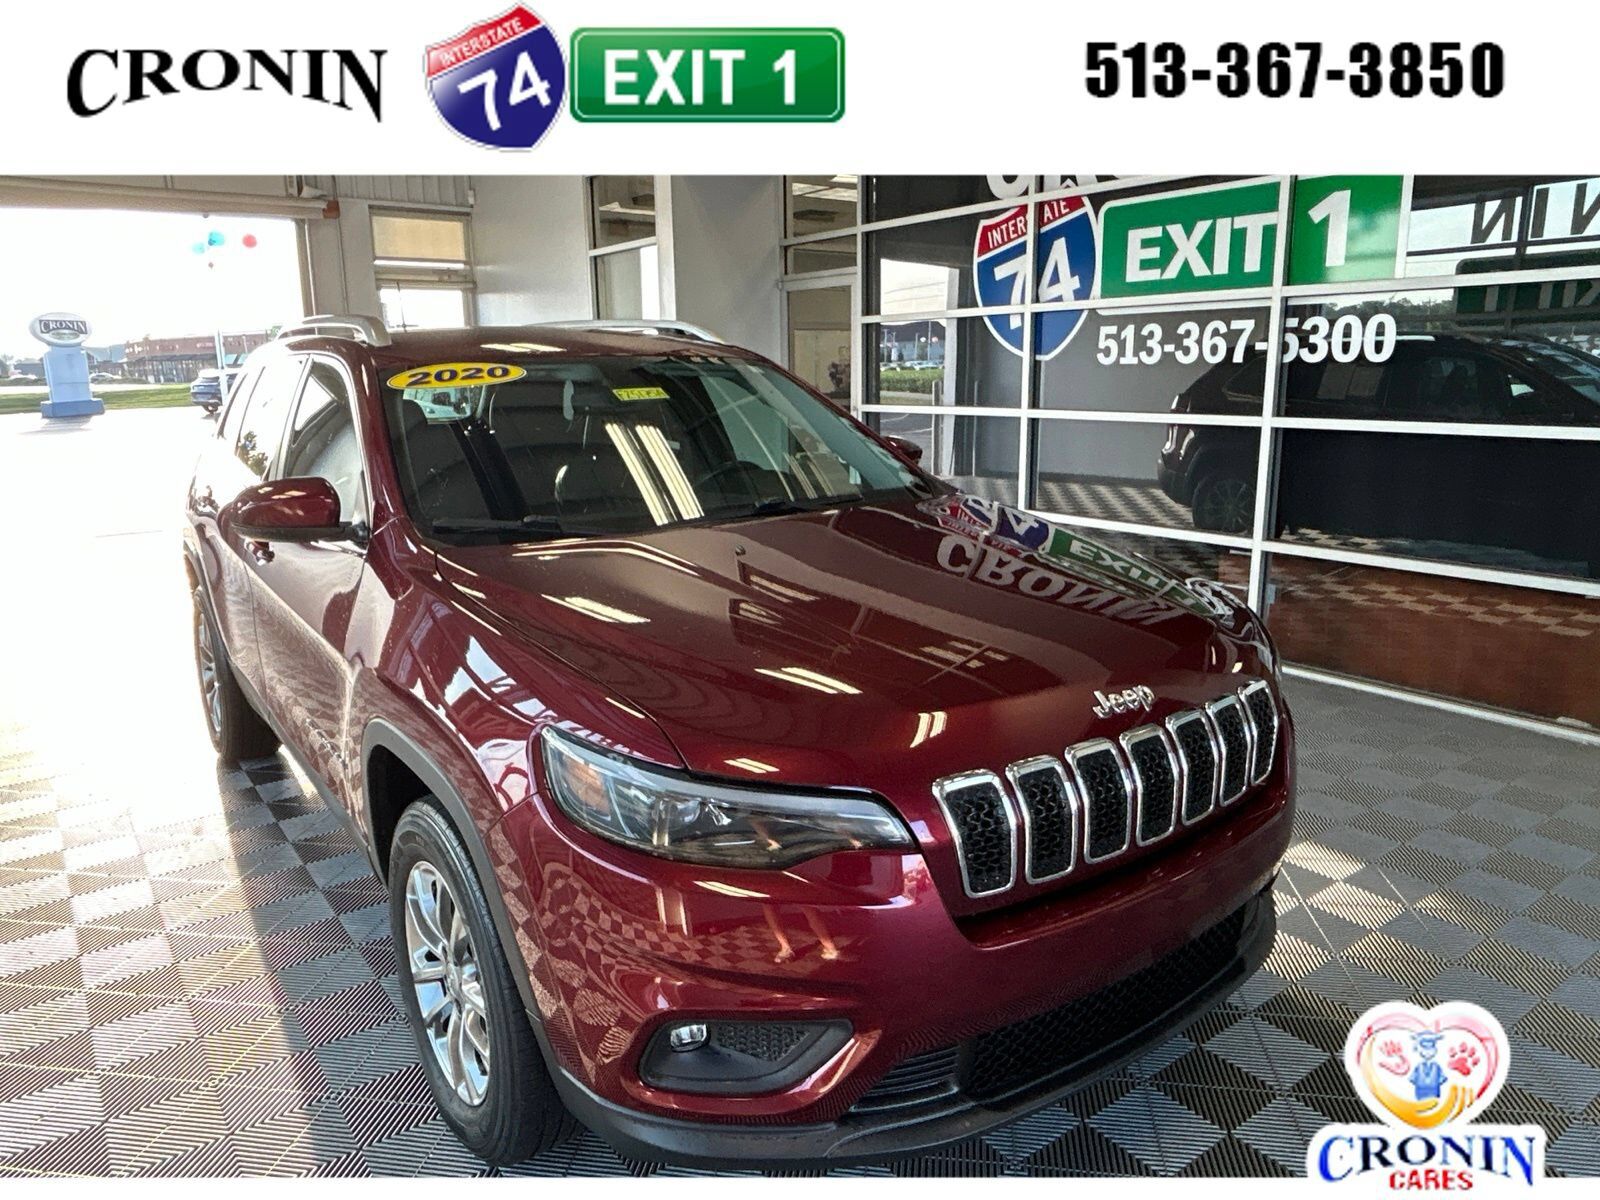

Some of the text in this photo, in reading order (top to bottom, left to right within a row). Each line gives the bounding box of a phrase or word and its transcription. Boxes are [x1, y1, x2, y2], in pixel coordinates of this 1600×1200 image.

[988, 199, 1070, 250] INTERATE
[1126, 189, 1352, 283] EXIT 1
[994, 236, 1081, 331] 74
[40, 320, 87, 333] CRONIN
[1096, 313, 1397, 366] 513-367-5300
[407, 365, 511, 386] 2020
[1092, 685, 1155, 719] Jeep
